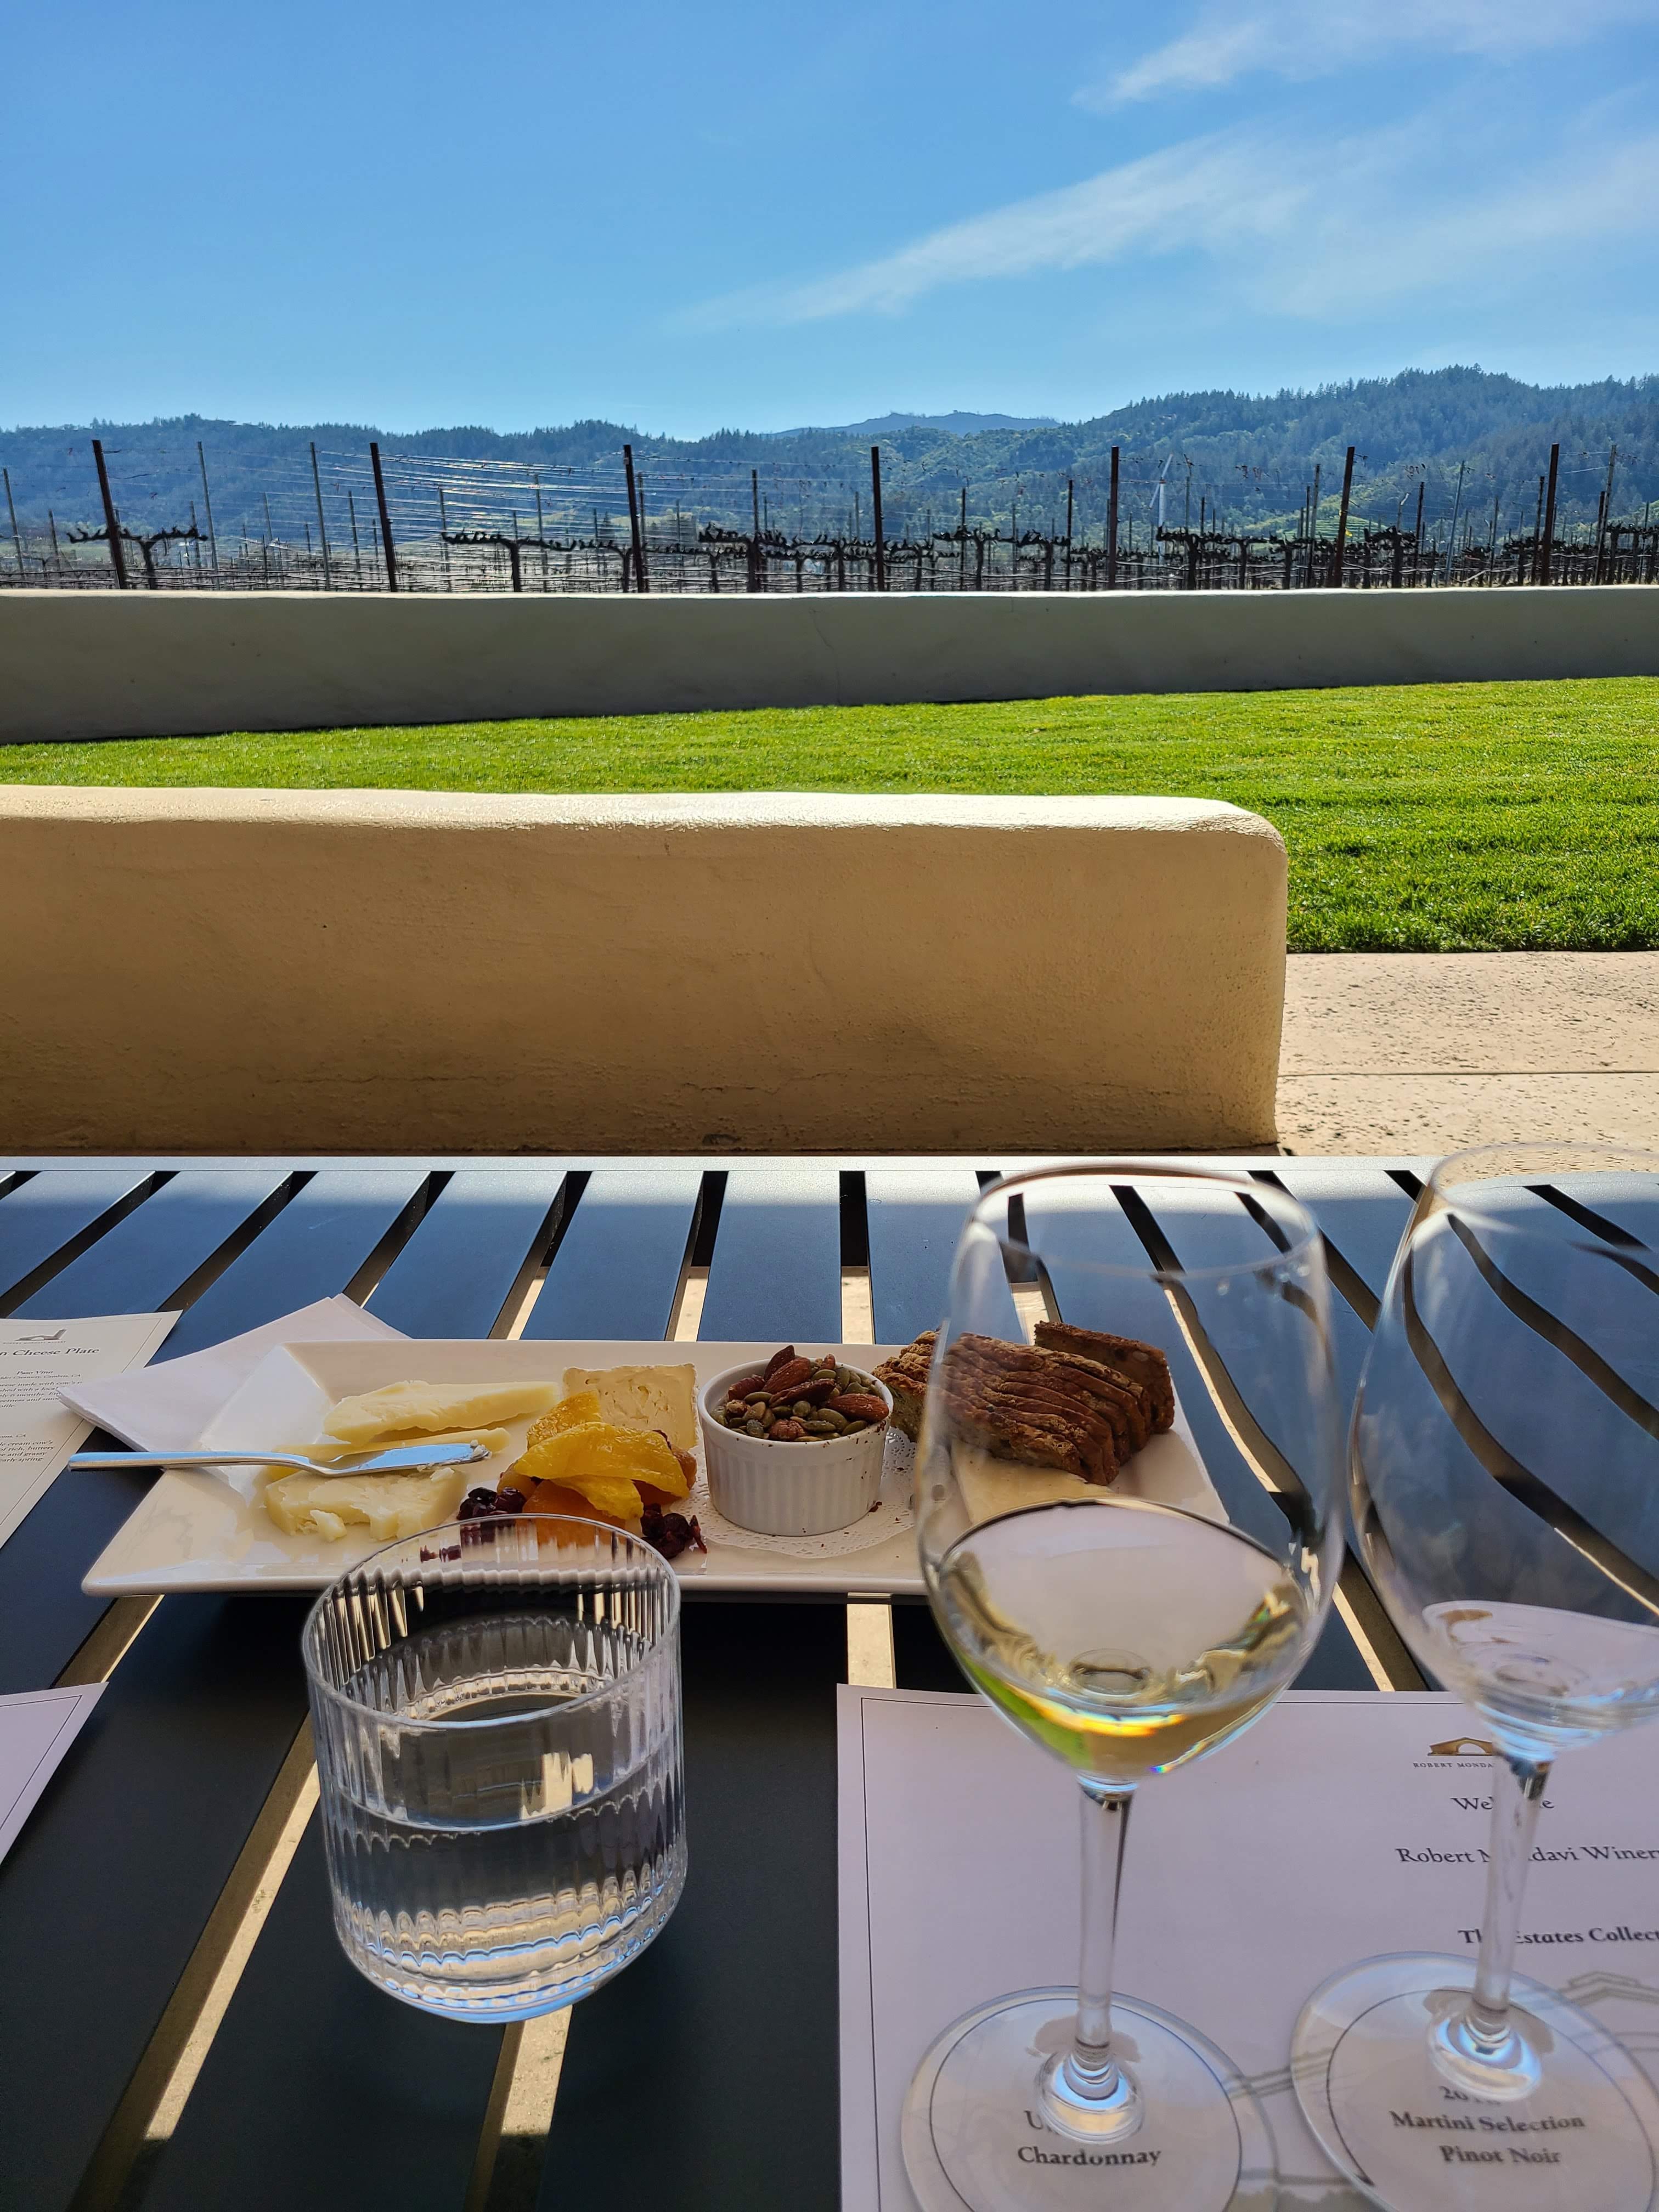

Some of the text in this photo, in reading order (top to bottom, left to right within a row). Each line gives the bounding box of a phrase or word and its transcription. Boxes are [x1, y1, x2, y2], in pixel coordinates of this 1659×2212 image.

[1395, 1847, 1475, 1863] Robert
[1579, 1846, 1659, 1859] Winer
[1389, 2111, 1586, 2132] Martini Selection
[1017, 2146, 1162, 2166] Chardonnay
[1439, 2145, 1561, 2163] Pinot Noir
